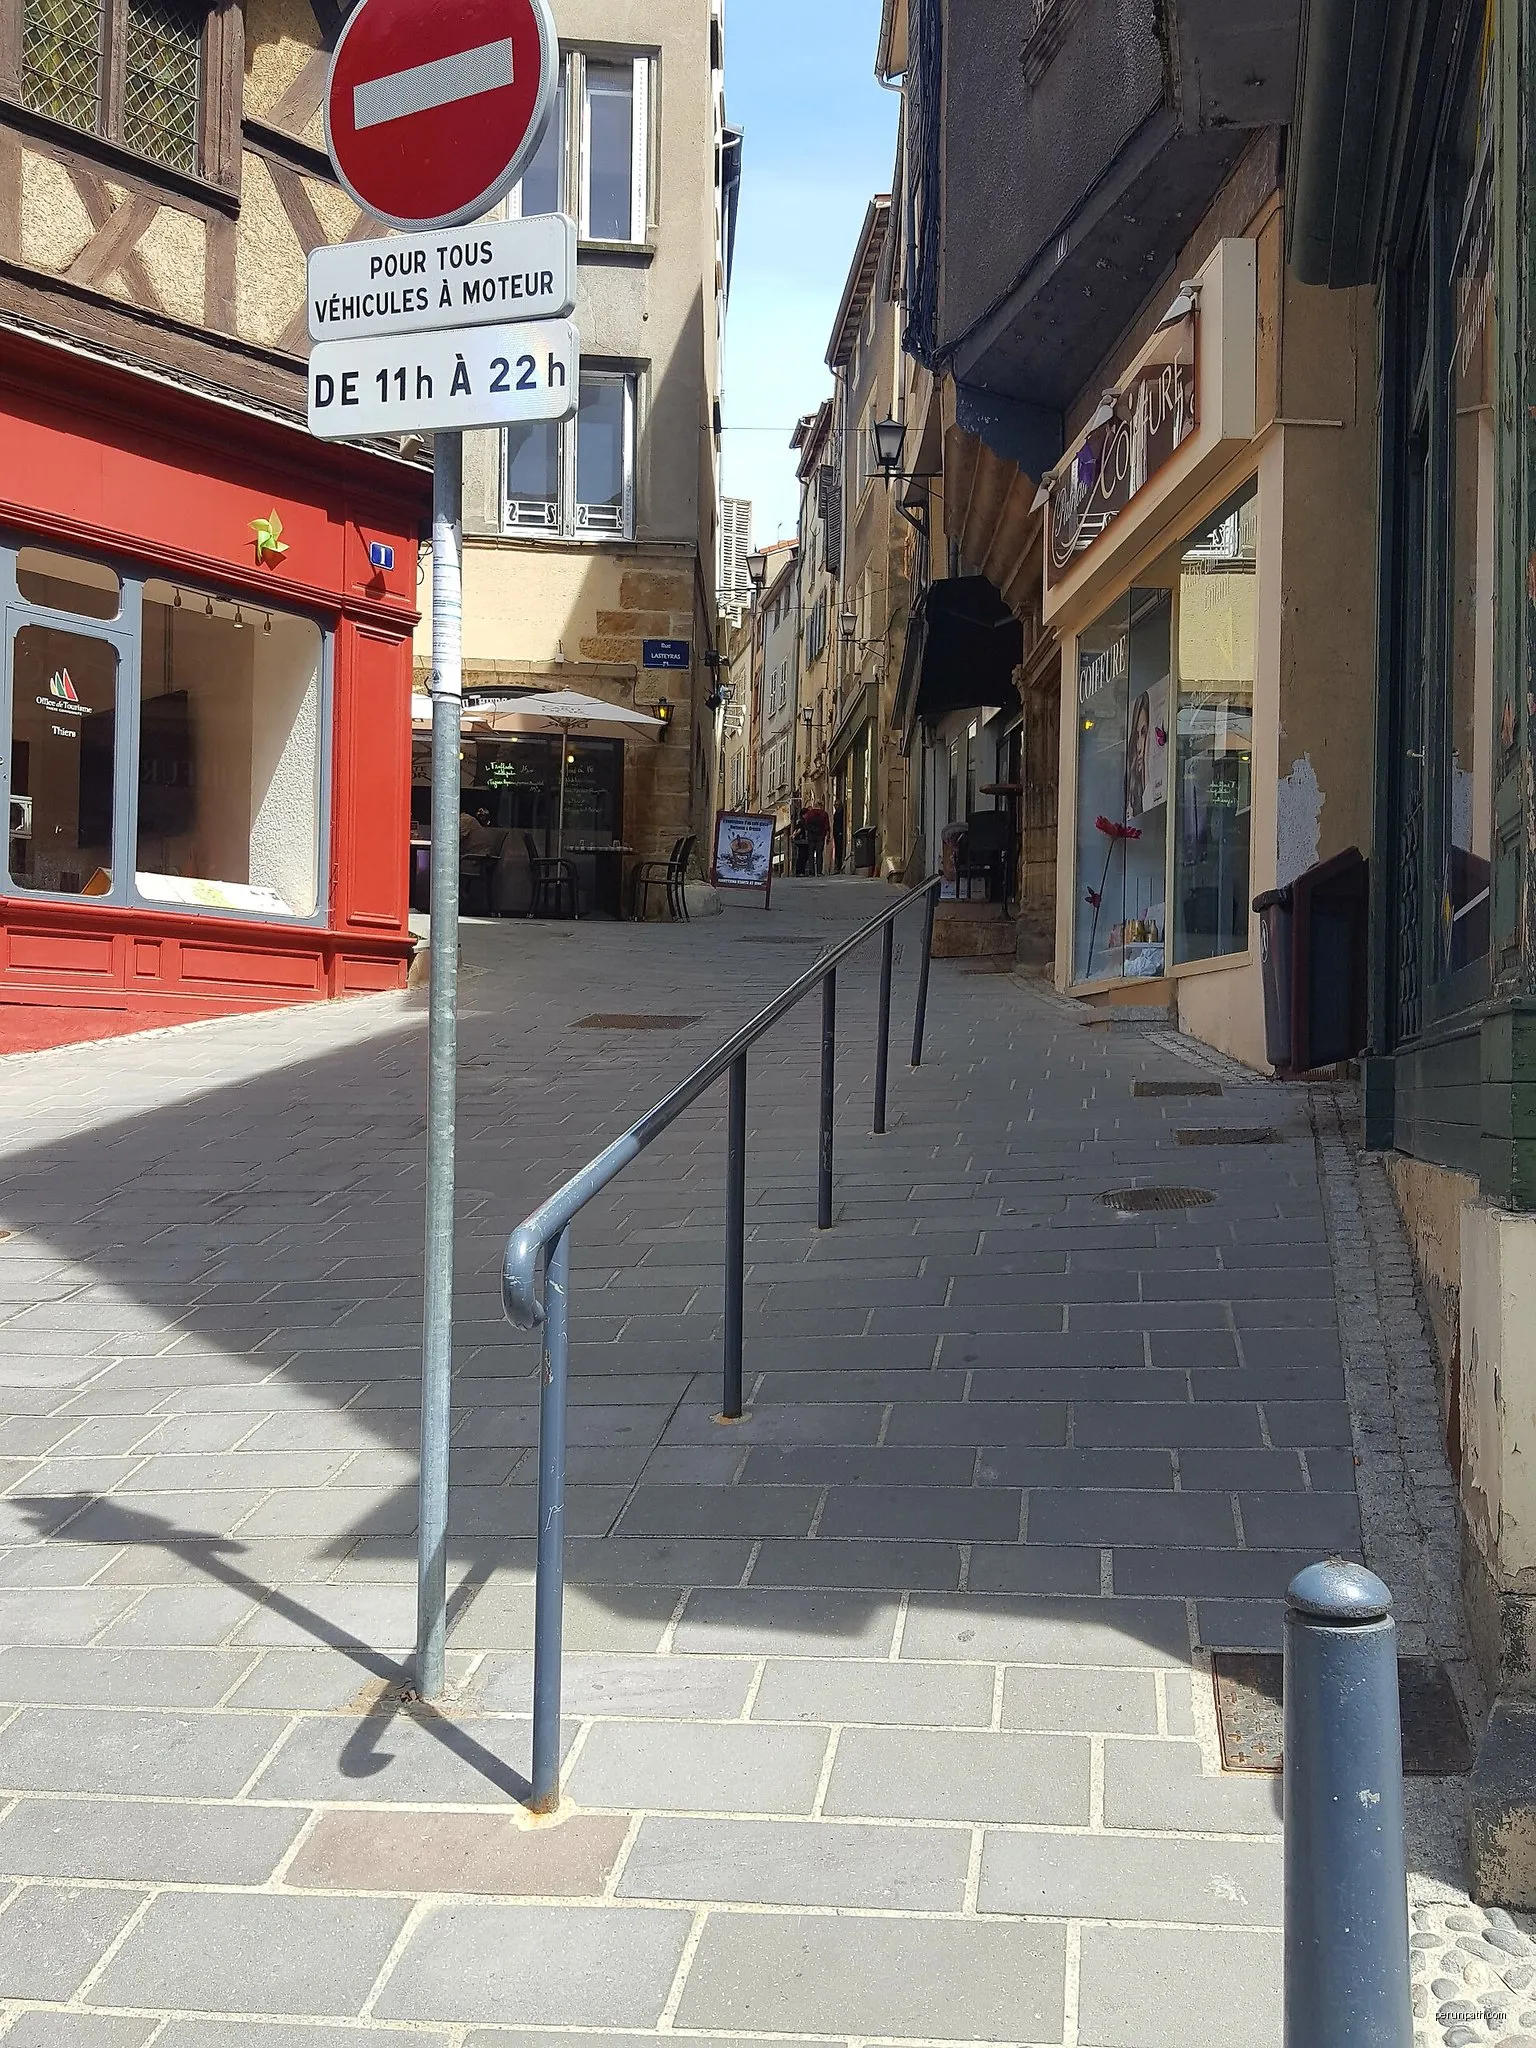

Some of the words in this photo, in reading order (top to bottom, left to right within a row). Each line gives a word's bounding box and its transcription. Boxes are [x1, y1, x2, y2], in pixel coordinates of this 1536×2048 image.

[370, 250, 426, 280] POUR
[437, 241, 493, 270] TOUS
[315, 287, 429, 323] VÉHICULES
[439, 279, 453, 308] À
[463, 270, 554, 305] MOTEUR
[315, 371, 359, 408] DE
[376, 366, 433, 402] 11h
[450, 353, 472, 397] À
[489, 353, 566, 393] 22h
[1080, 634, 1126, 704] COIFFURE
[36, 696, 56, 707] Office
[63, 701, 92, 713] Tourisme
[52, 725, 76, 737] Thiers
